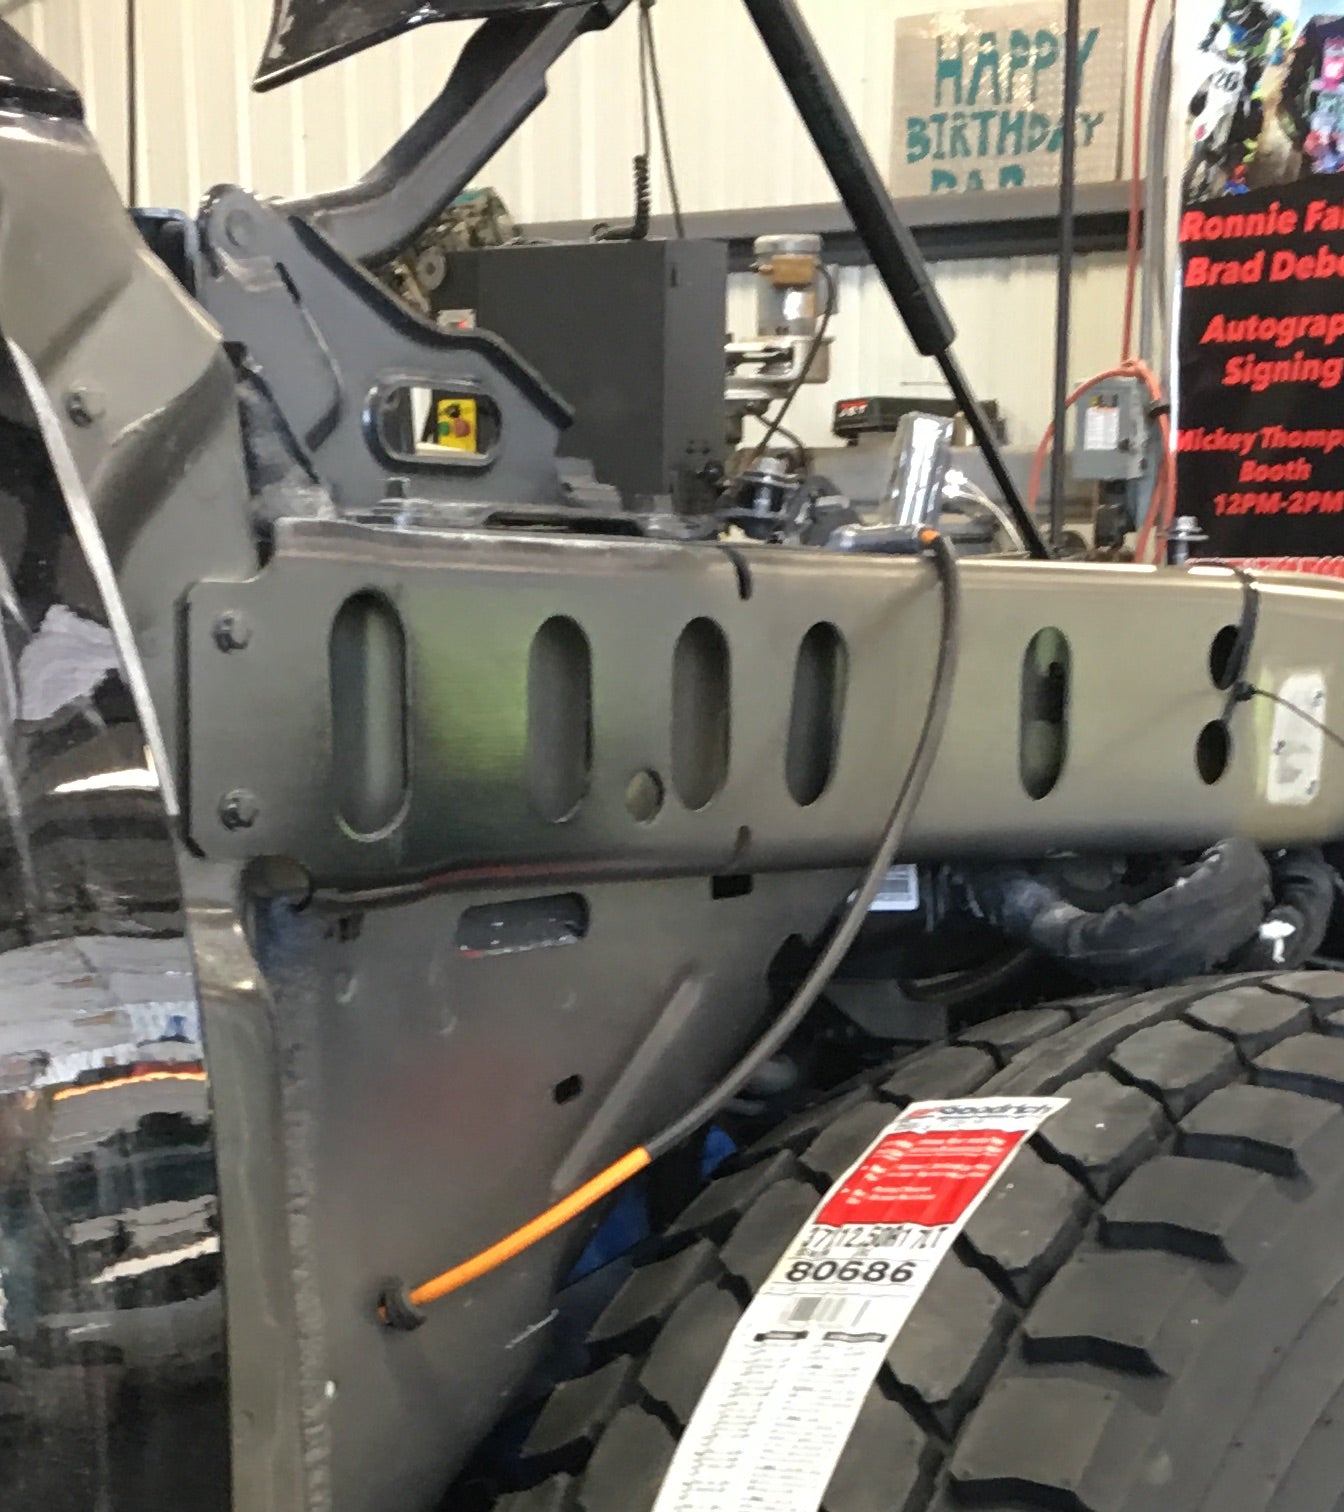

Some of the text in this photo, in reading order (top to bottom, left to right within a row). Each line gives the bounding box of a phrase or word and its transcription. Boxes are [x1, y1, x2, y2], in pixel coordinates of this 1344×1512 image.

[934, 27, 1100, 107] HAPPY
[906, 111, 1104, 164] BIRTHDAY
[1179, 201, 1298, 243] Ronnie
[1184, 250, 1266, 288] Brad
[1177, 426, 1258, 456] Mickey
[1239, 457, 1313, 482] Booth
[786, 1260, 917, 1283] 80686
